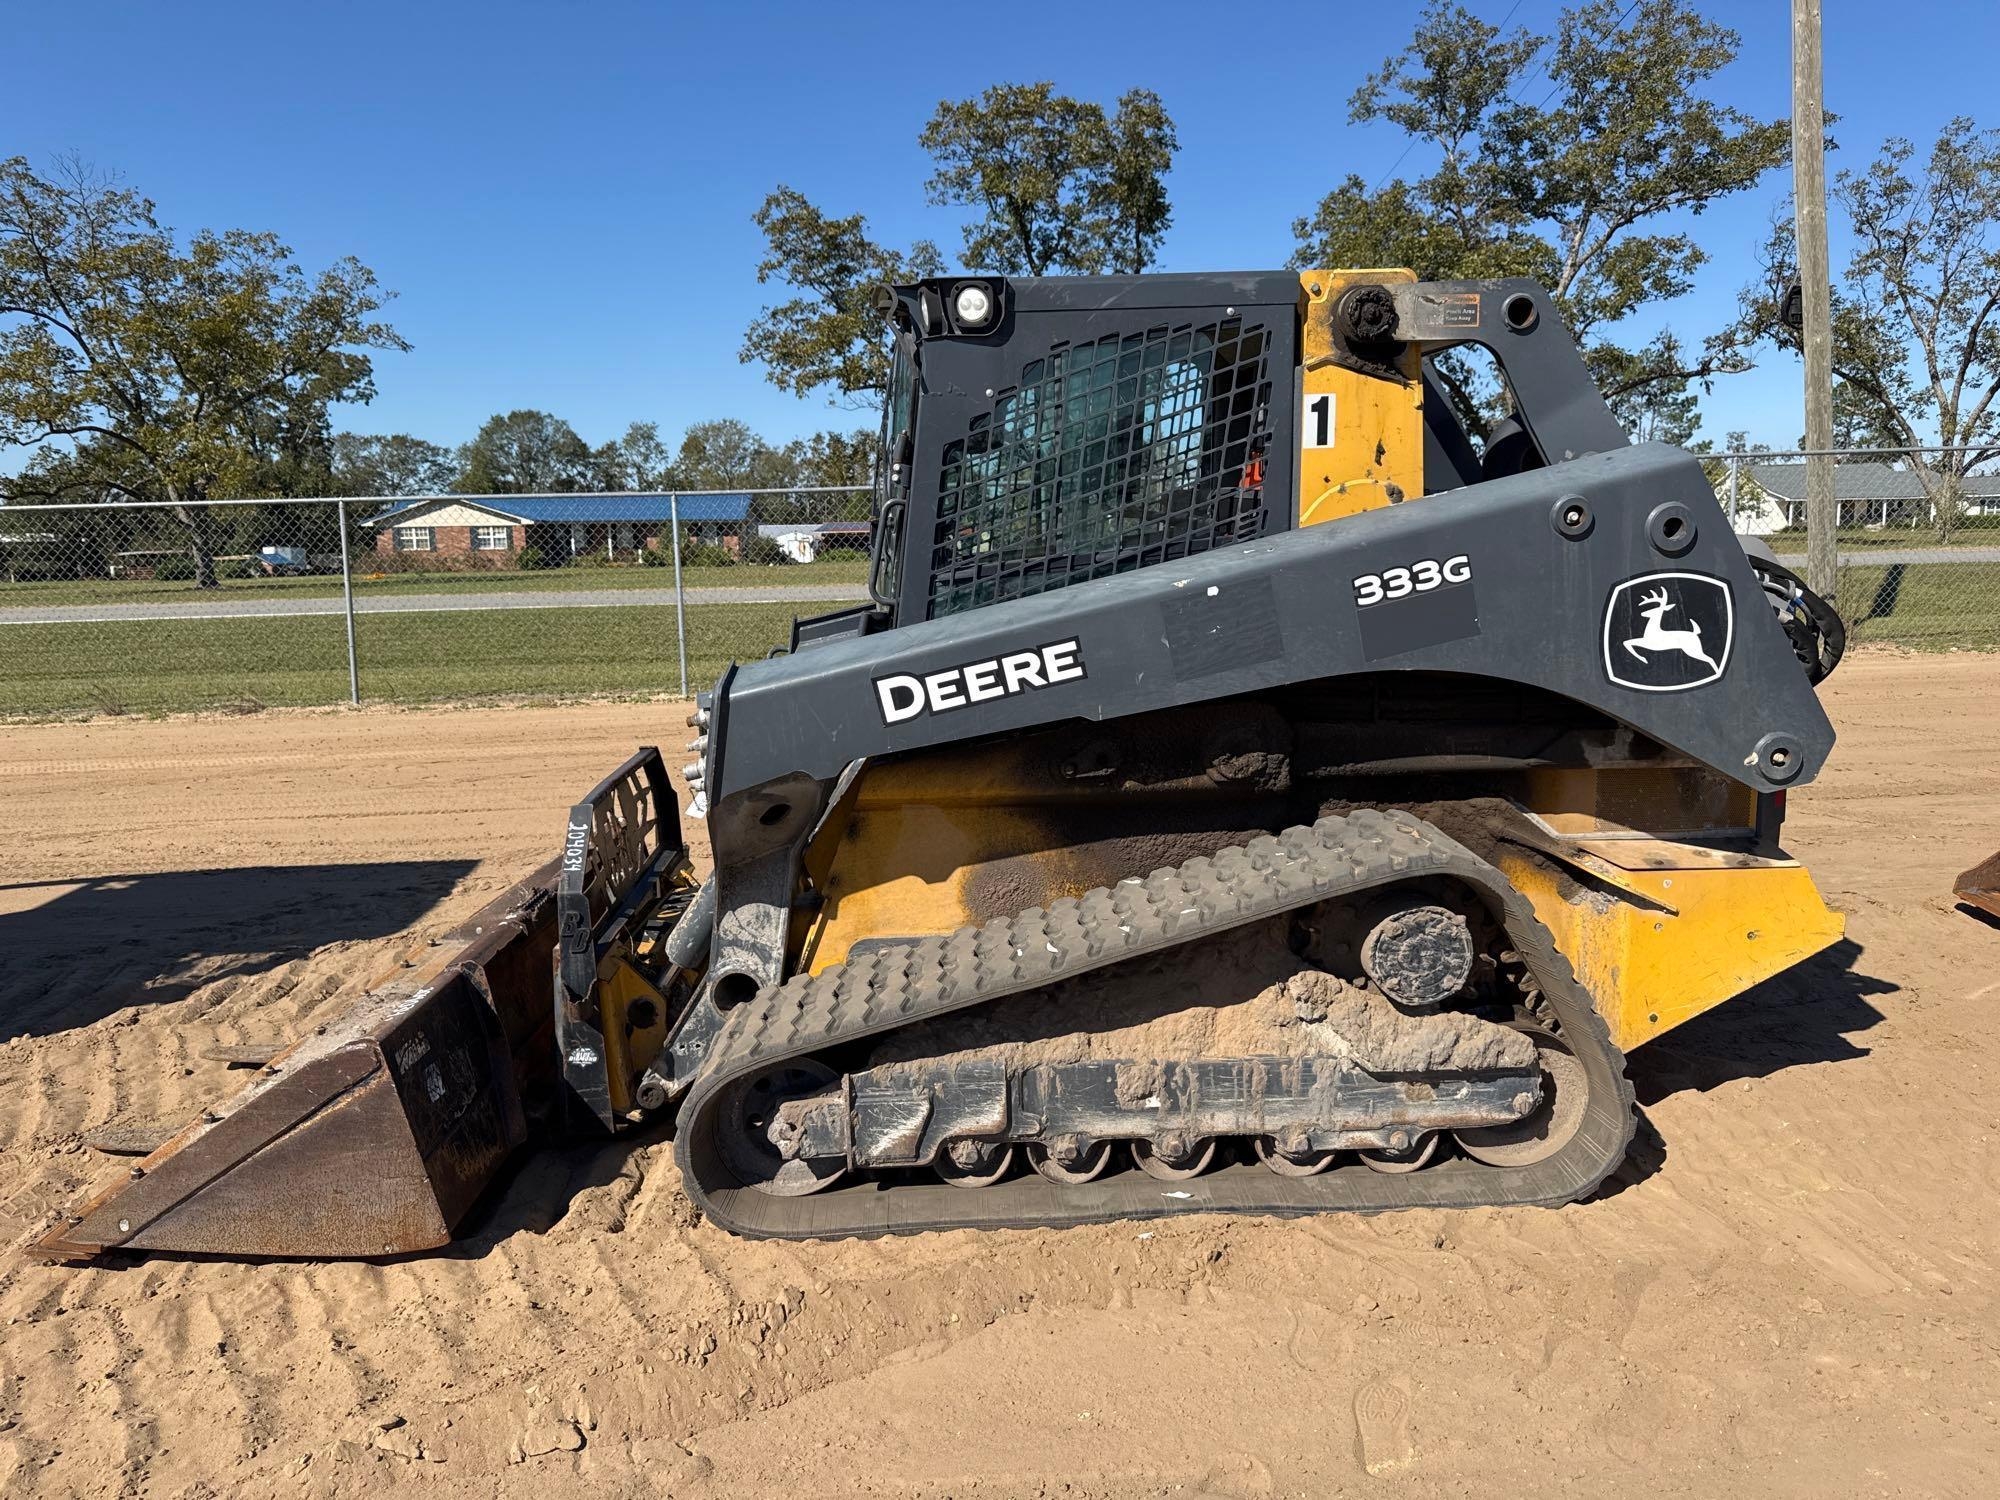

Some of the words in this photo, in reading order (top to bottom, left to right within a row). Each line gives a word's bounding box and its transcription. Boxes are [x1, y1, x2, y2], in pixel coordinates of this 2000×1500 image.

[1311, 396, 1329, 446] 1
[1353, 554, 1472, 607] 333G
[876, 640, 1085, 724] DEERE
